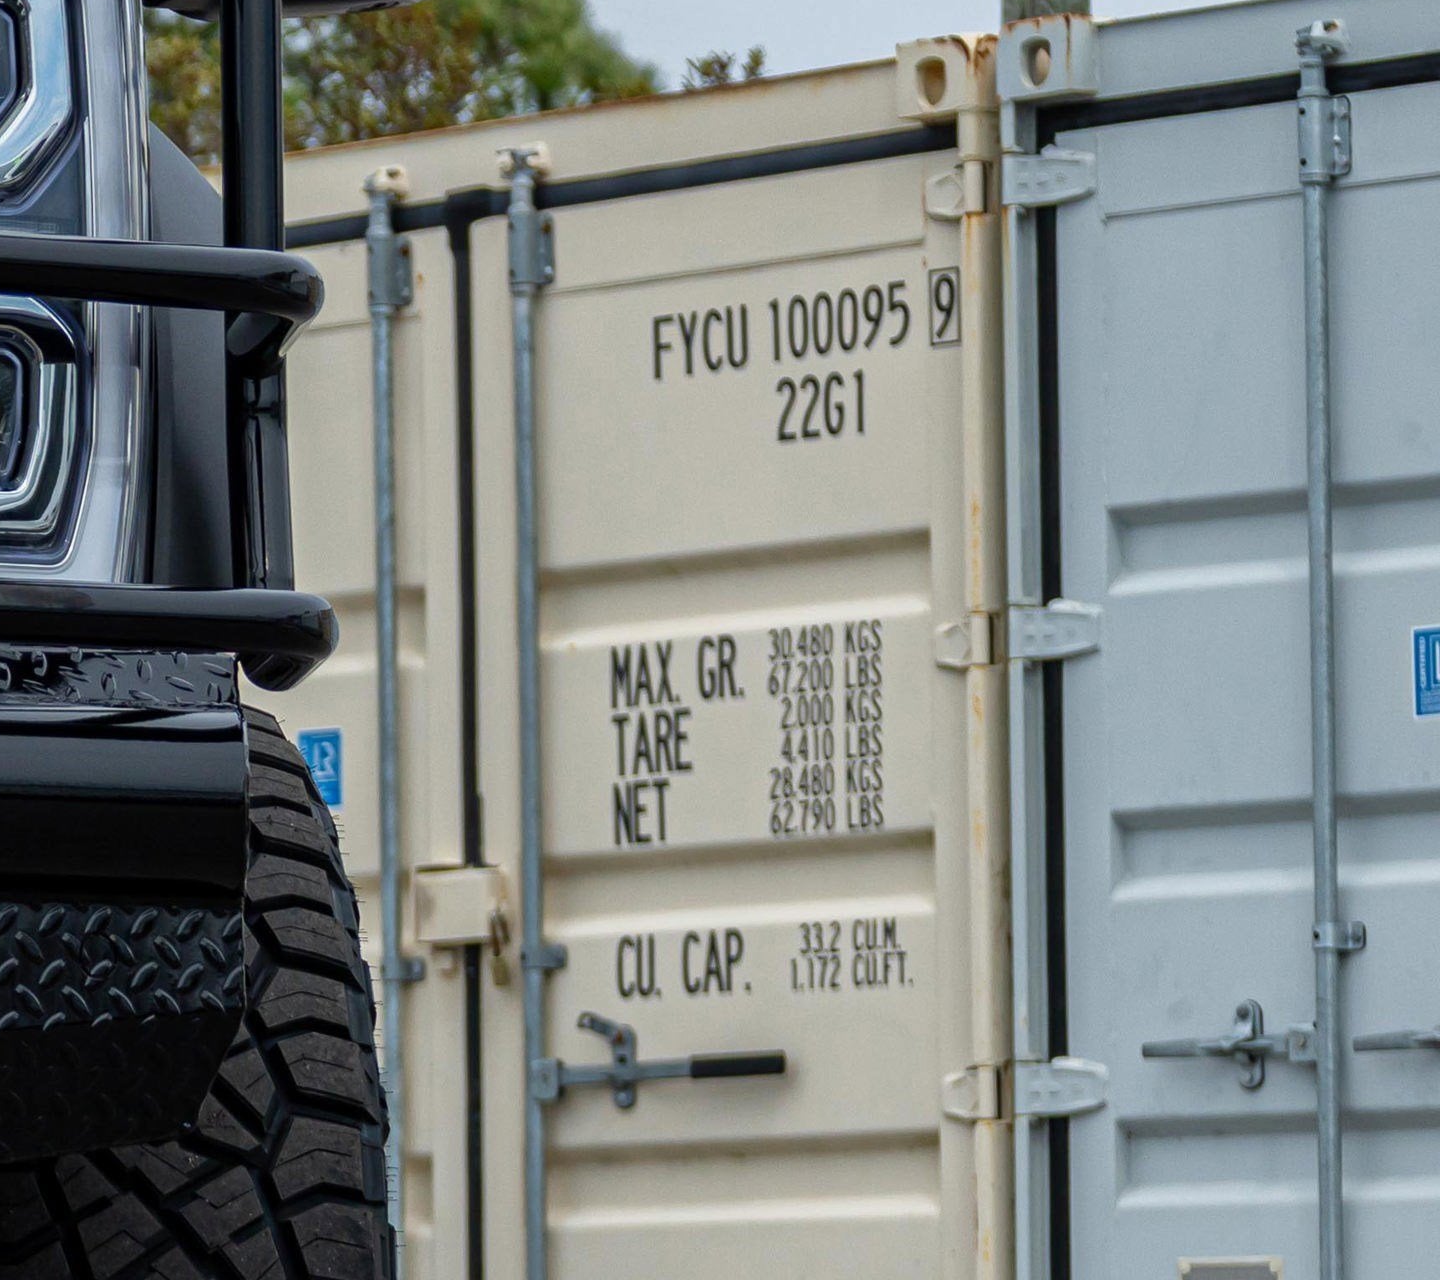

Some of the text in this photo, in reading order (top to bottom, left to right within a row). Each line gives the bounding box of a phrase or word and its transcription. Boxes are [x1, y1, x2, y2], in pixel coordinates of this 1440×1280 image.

[652, 271, 957, 380] FYCU 100095 9
[776, 368, 865, 442] 22G1
[768, 618, 882, 661] 30.480 KGS
[610, 633, 746, 709] MAX. GR.
[768, 653, 882, 696] 67.200 LBS
[845, 688, 883, 723] KGS
[611, 705, 693, 776] TARE
[781, 723, 883, 764] 4.410 LBS
[770, 758, 883, 800] 28.480 KGS
[613, 776, 670, 846] NET
[770, 793, 884, 834] 62.790 LBS
[799, 919, 841, 954] 33.2
[617, 927, 752, 998] CU. CAP.
[790, 954, 841, 990] 1.172
